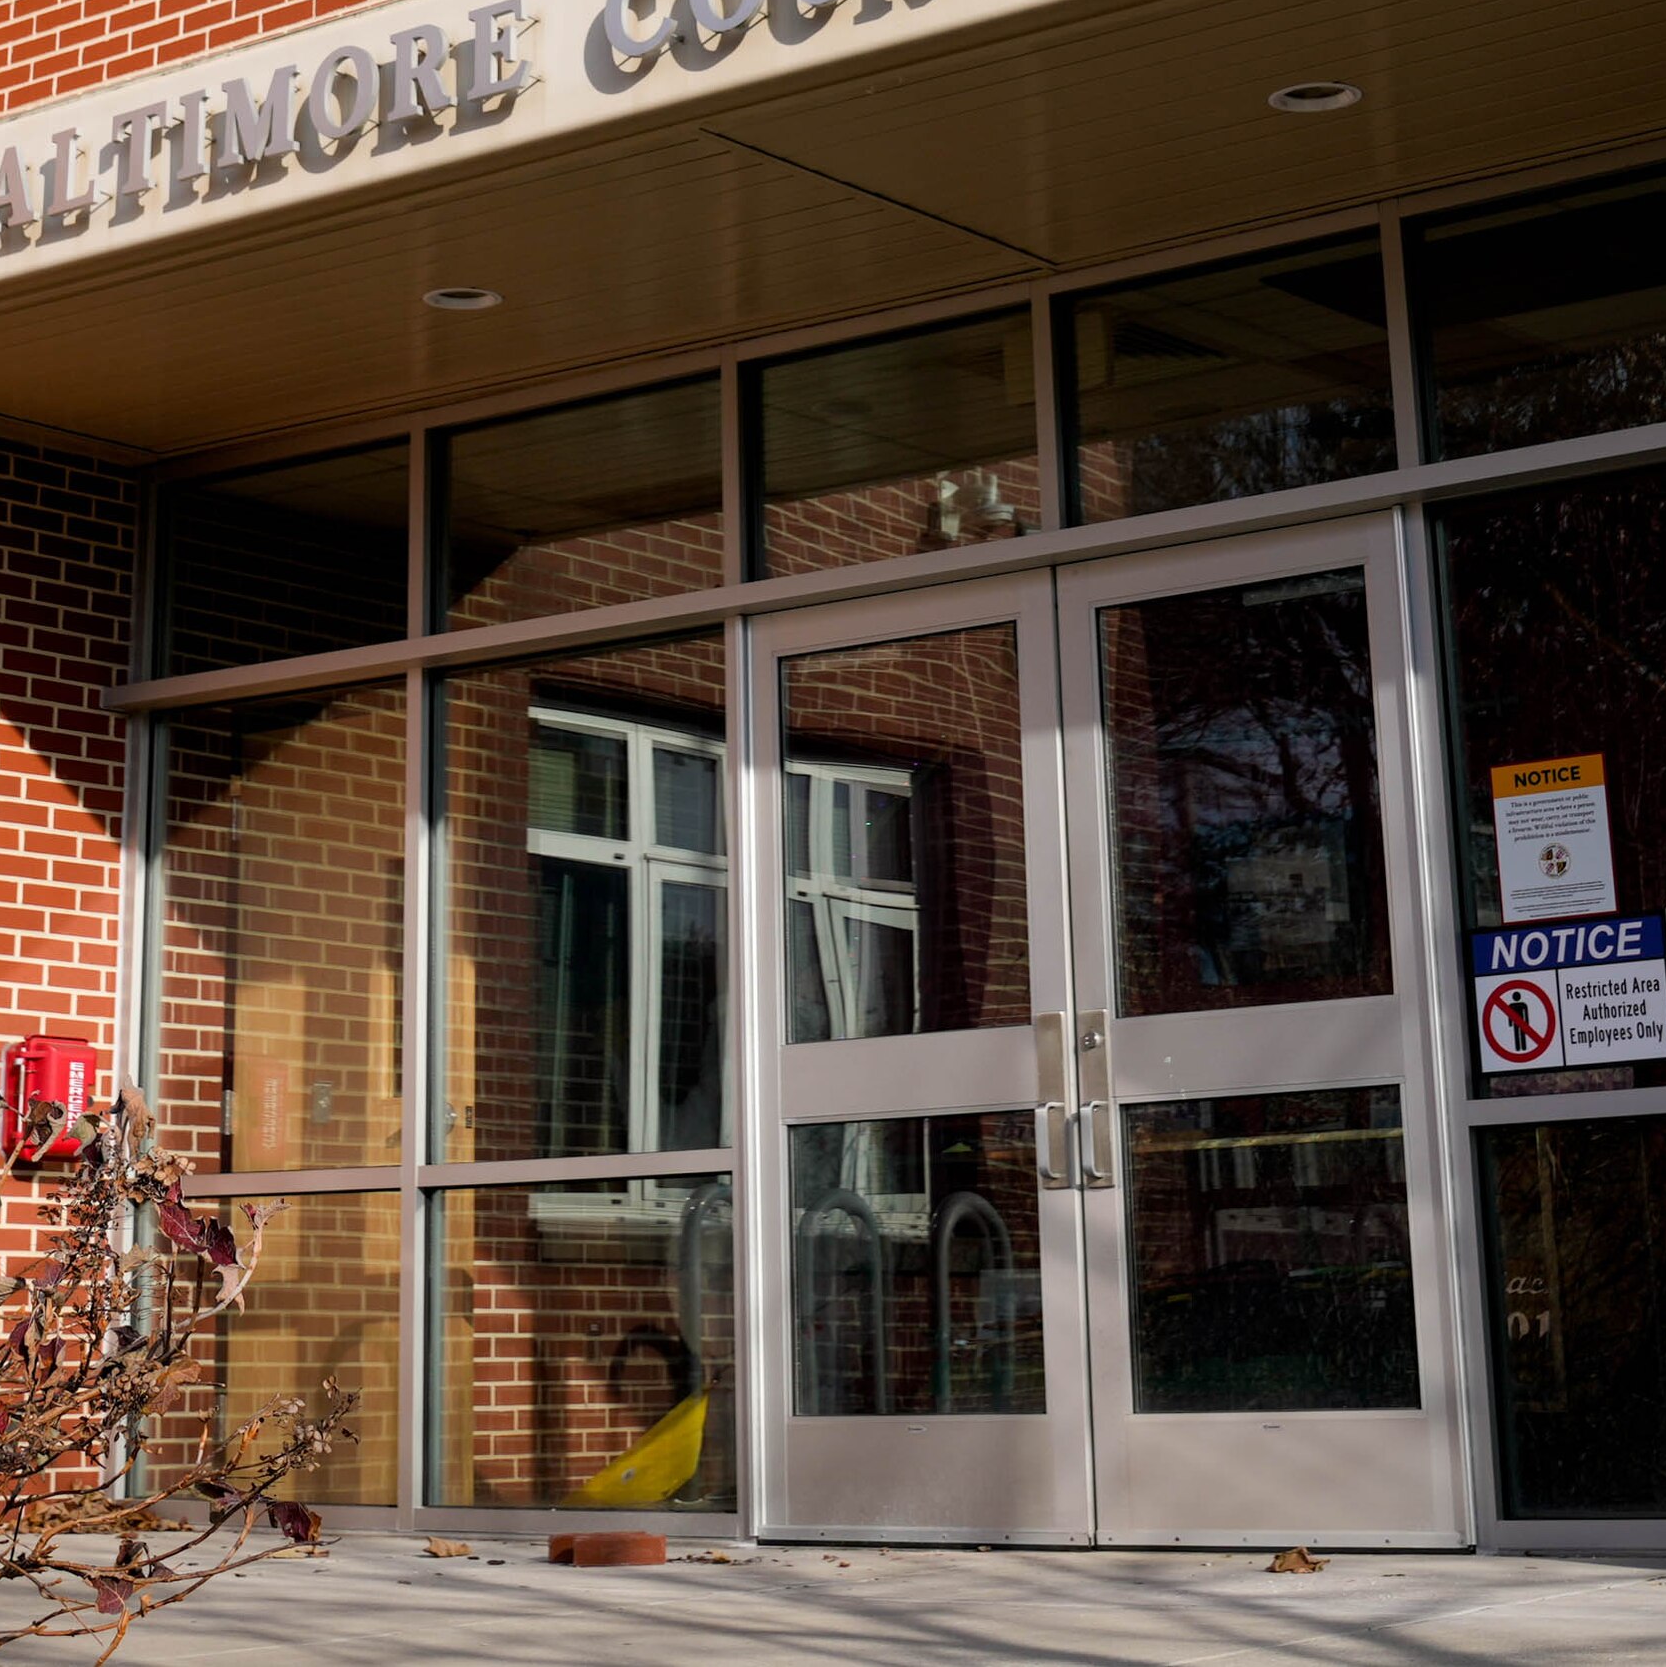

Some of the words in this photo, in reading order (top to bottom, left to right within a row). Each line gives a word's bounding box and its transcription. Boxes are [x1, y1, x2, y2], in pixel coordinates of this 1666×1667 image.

[1514, 765, 1581, 788] NOTICE
[1491, 921, 1643, 970] NOTICE
[1566, 979, 1627, 999] Restricted
[1632, 977, 1660, 993] Area
[1583, 999, 1646, 1021] Authorized
[1570, 1026, 1633, 1048] Employees
[1636, 1021, 1663, 1042] Only
[66, 1061, 85, 1133] EMERGENC
